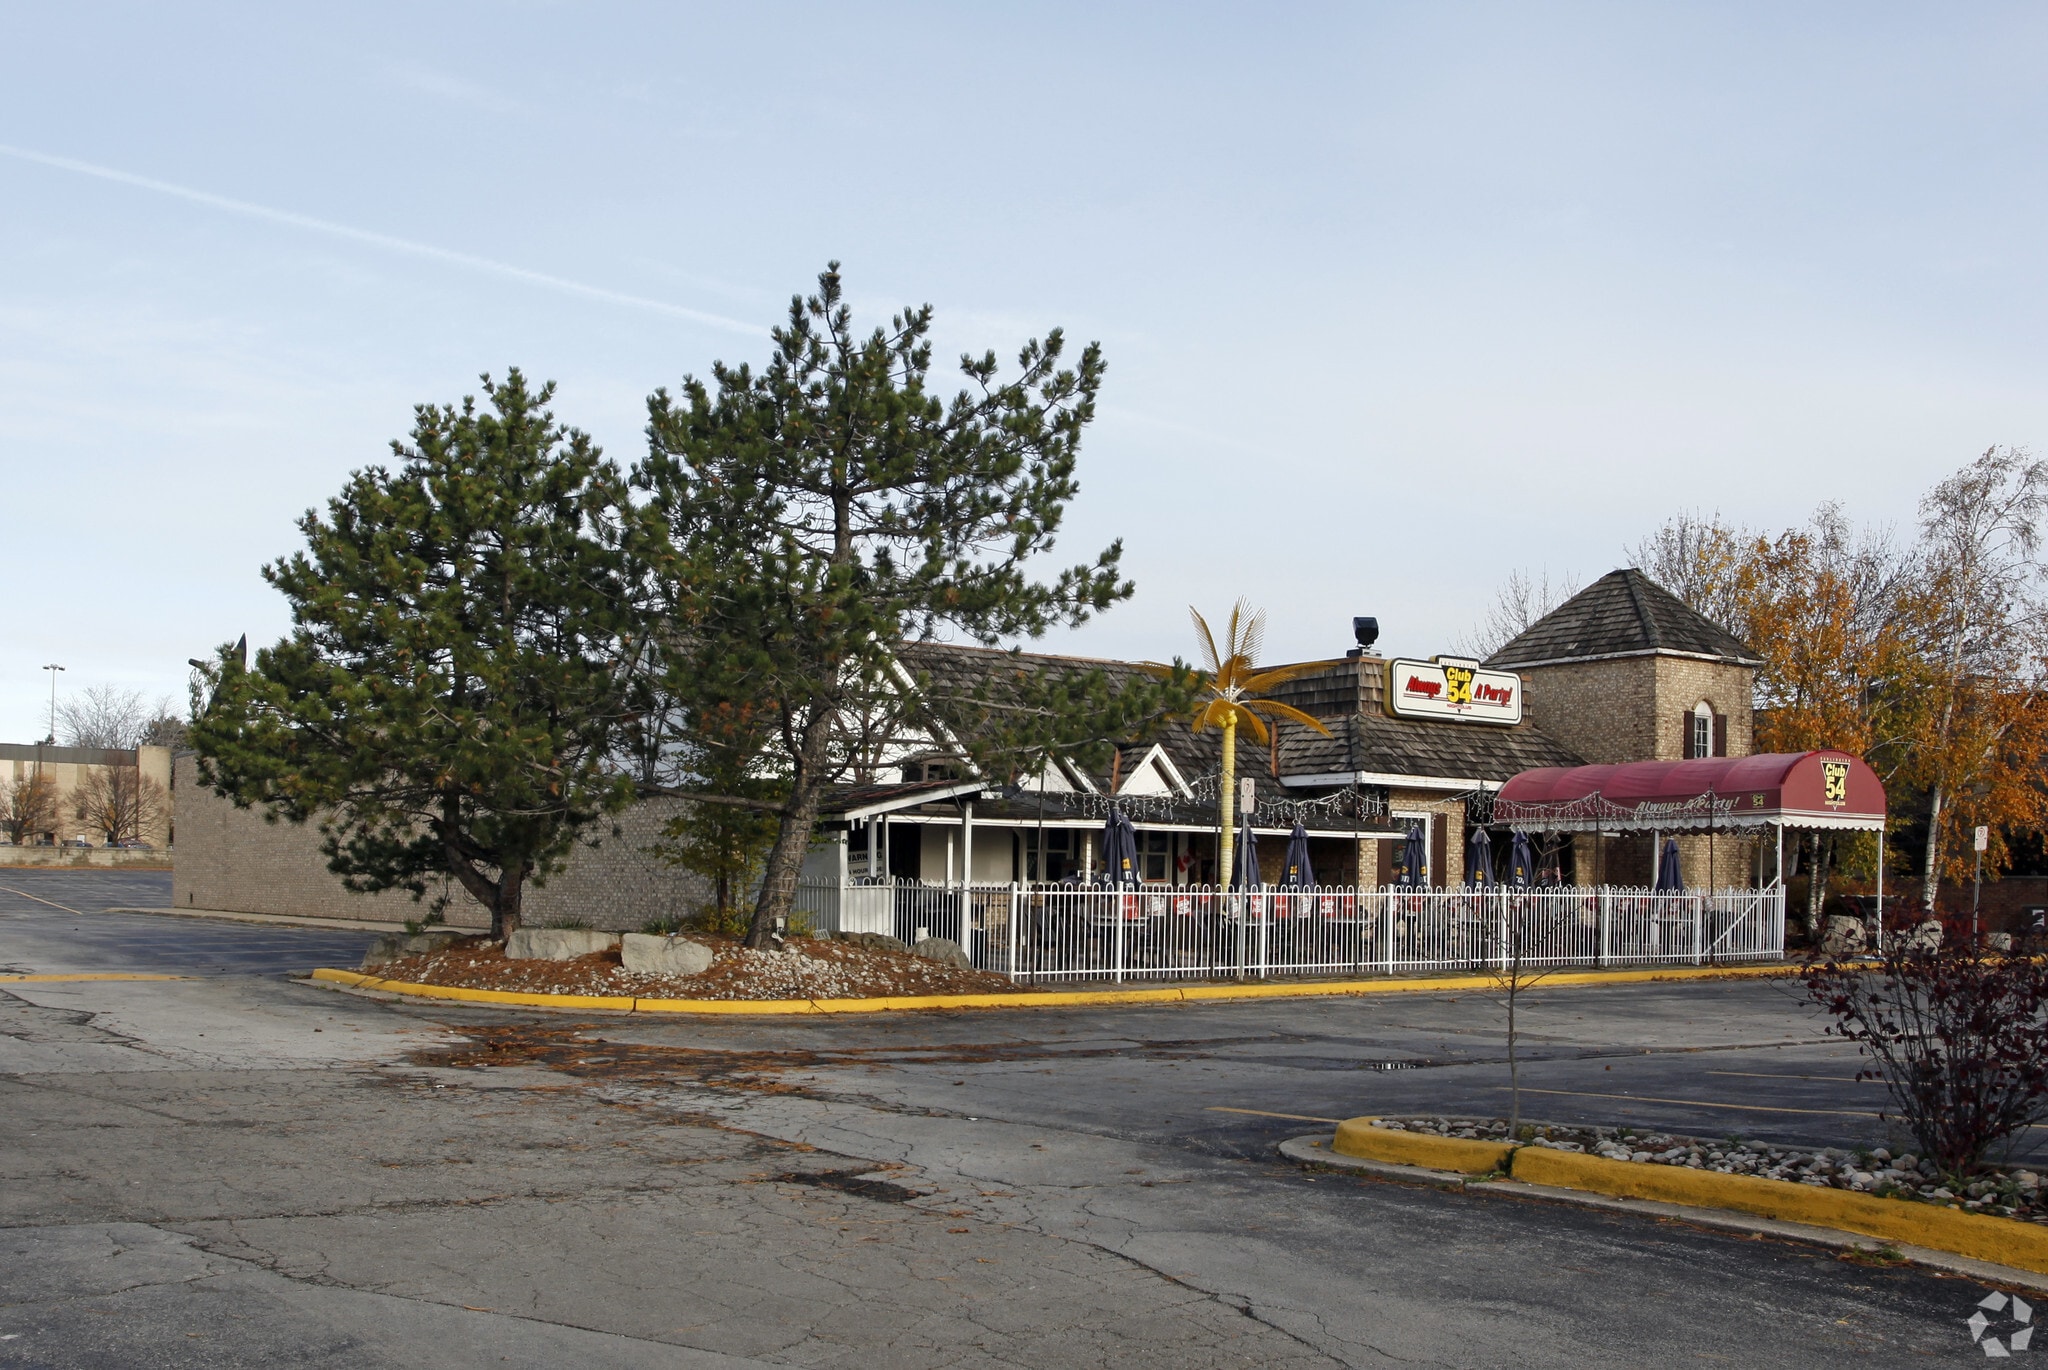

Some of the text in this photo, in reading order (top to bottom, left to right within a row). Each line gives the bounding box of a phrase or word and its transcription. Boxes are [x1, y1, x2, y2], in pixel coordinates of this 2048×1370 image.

[1446, 667, 1472, 681] Club
[1405, 675, 1513, 707] Always A Party!
[1447, 681, 1472, 704] 54
[1825, 763, 1846, 777] Club
[1825, 776, 1846, 800] 54
[1636, 801, 1682, 812] Always
